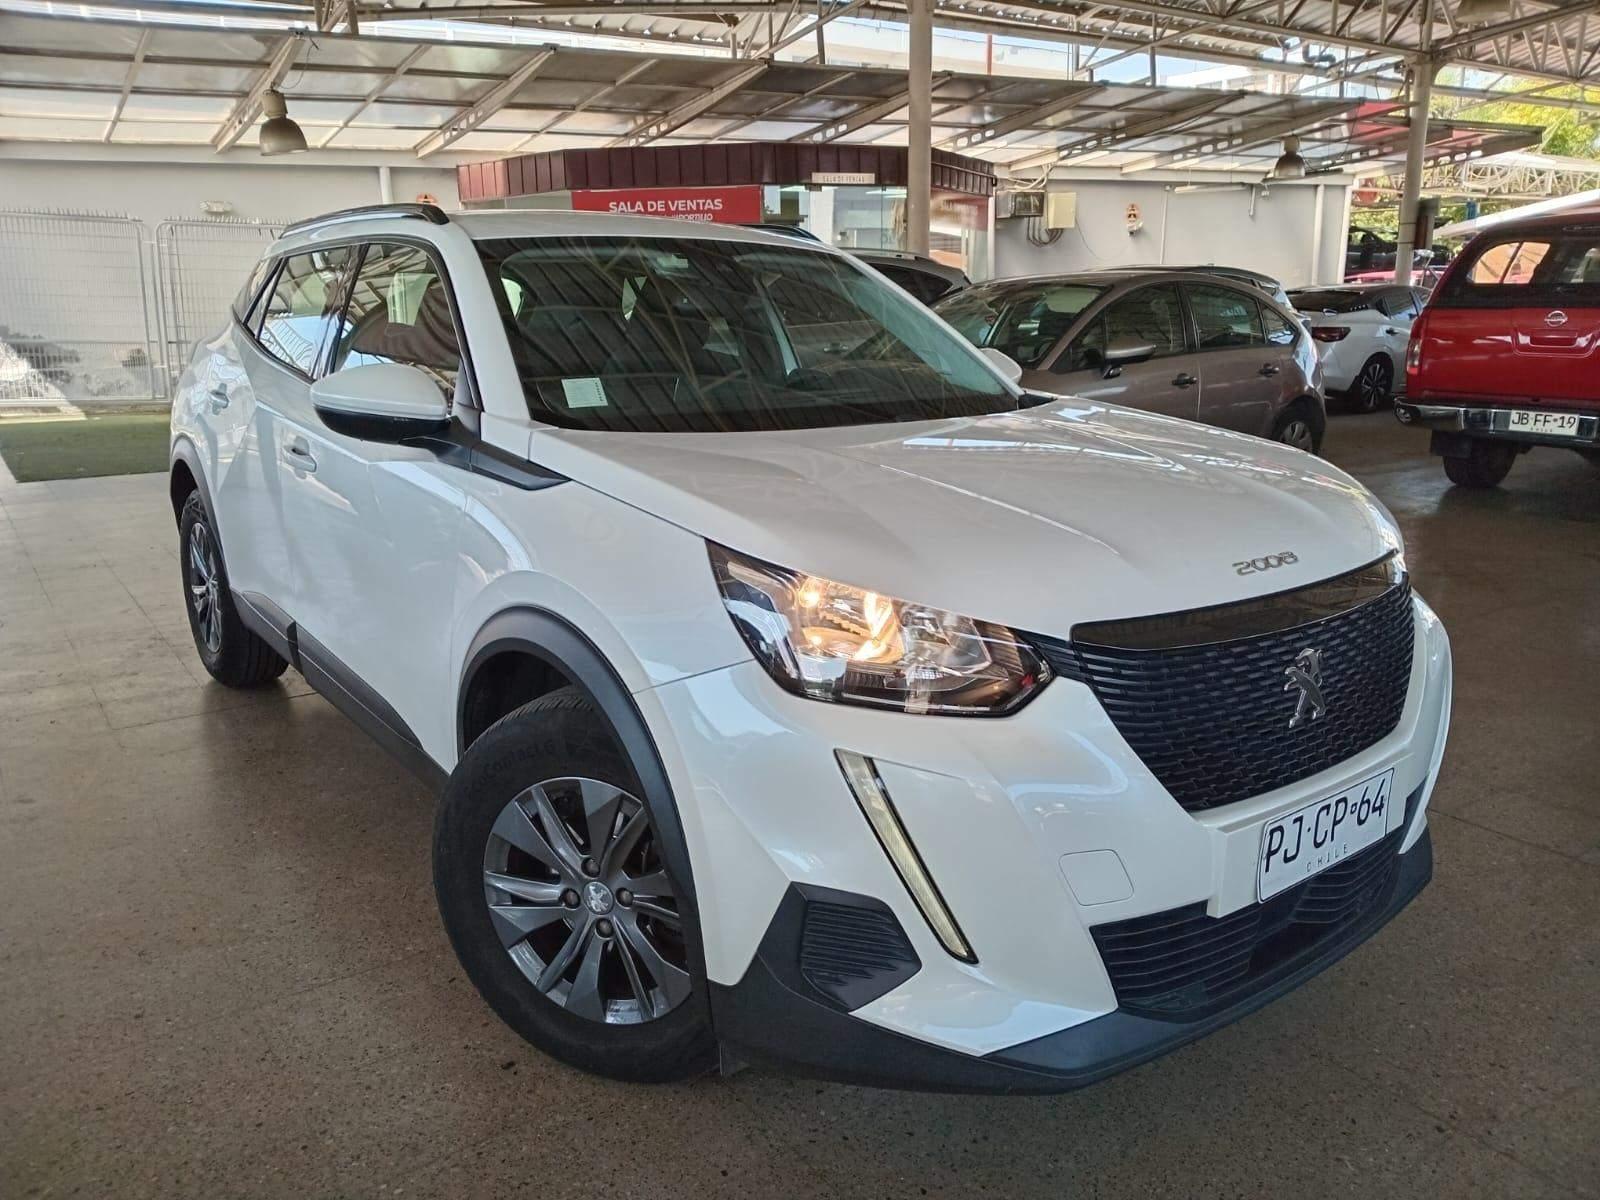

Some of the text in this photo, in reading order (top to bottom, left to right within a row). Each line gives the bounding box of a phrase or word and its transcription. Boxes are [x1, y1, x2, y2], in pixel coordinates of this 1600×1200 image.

[608, 198, 723, 213] SALA DE VENTAS
[1231, 550, 1299, 576] 2008
[1306, 844, 1349, 872] CHILE
